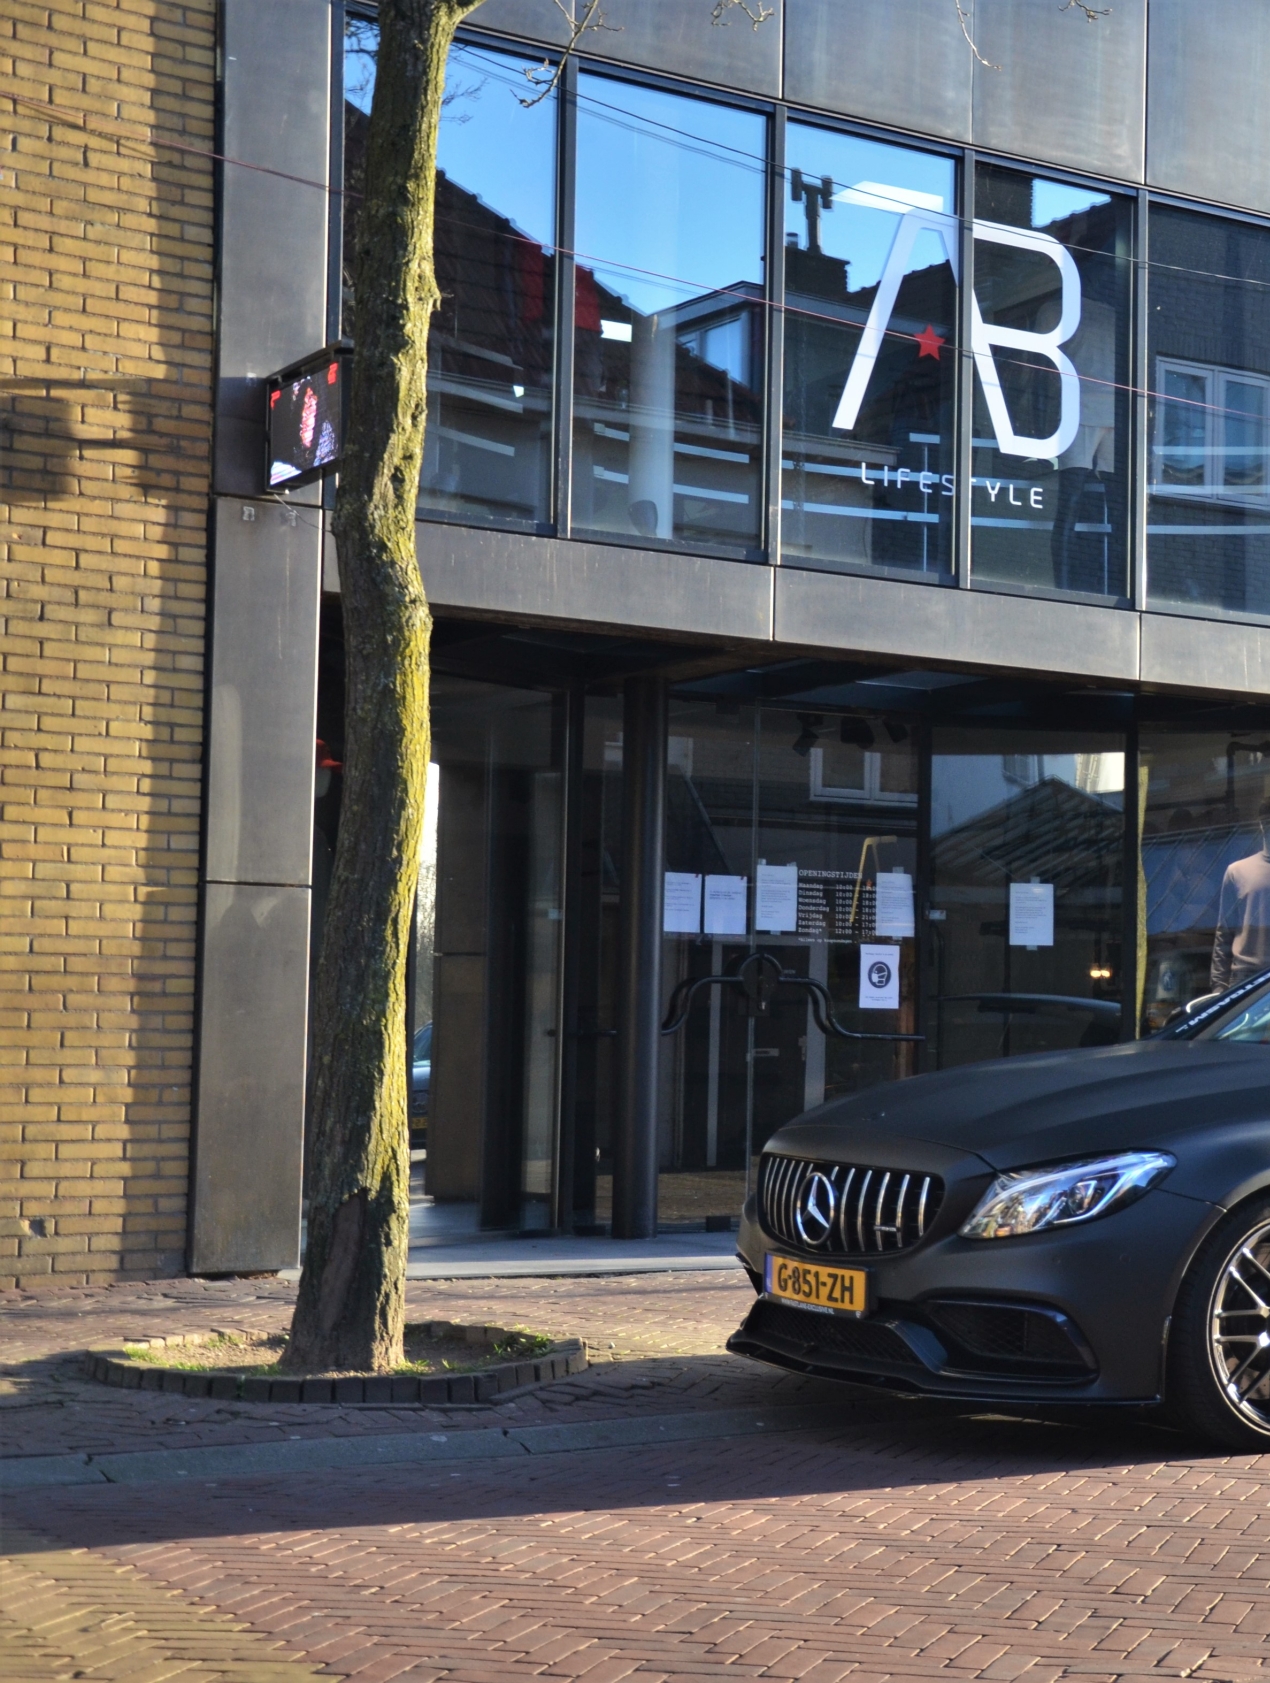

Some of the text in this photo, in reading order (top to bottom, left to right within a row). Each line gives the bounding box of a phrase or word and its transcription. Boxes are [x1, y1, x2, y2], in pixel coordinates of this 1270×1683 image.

[798, 869, 863, 879] OPENINGSTIJDEN
[798, 897, 826, 905] Woensdag
[798, 912, 823, 920] Vrijdag
[777, 1262, 855, 1306] G-851-ZH
